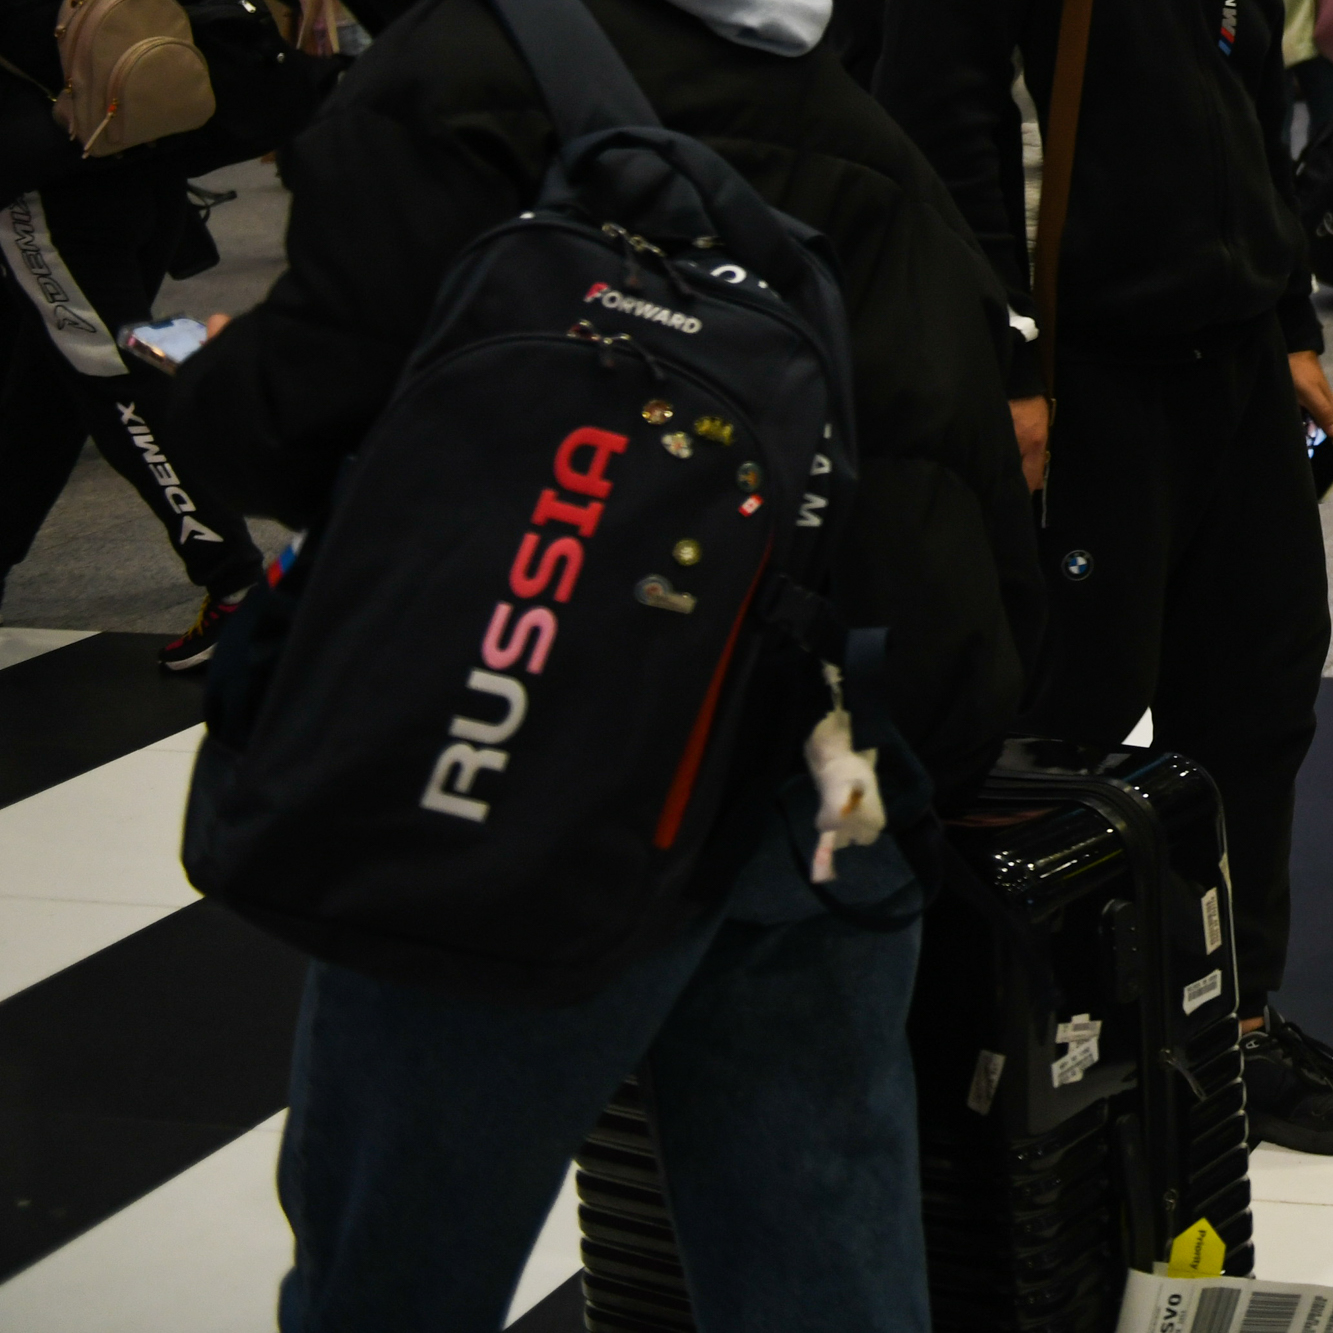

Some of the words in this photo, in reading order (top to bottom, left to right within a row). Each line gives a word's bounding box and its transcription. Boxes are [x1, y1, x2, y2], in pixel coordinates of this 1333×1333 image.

[583, 281, 703, 334] FORWARD
[115, 400, 197, 515] DEMIX
[419, 424, 630, 823] RUSSIA
[1190, 1229, 1207, 1271] Priority
